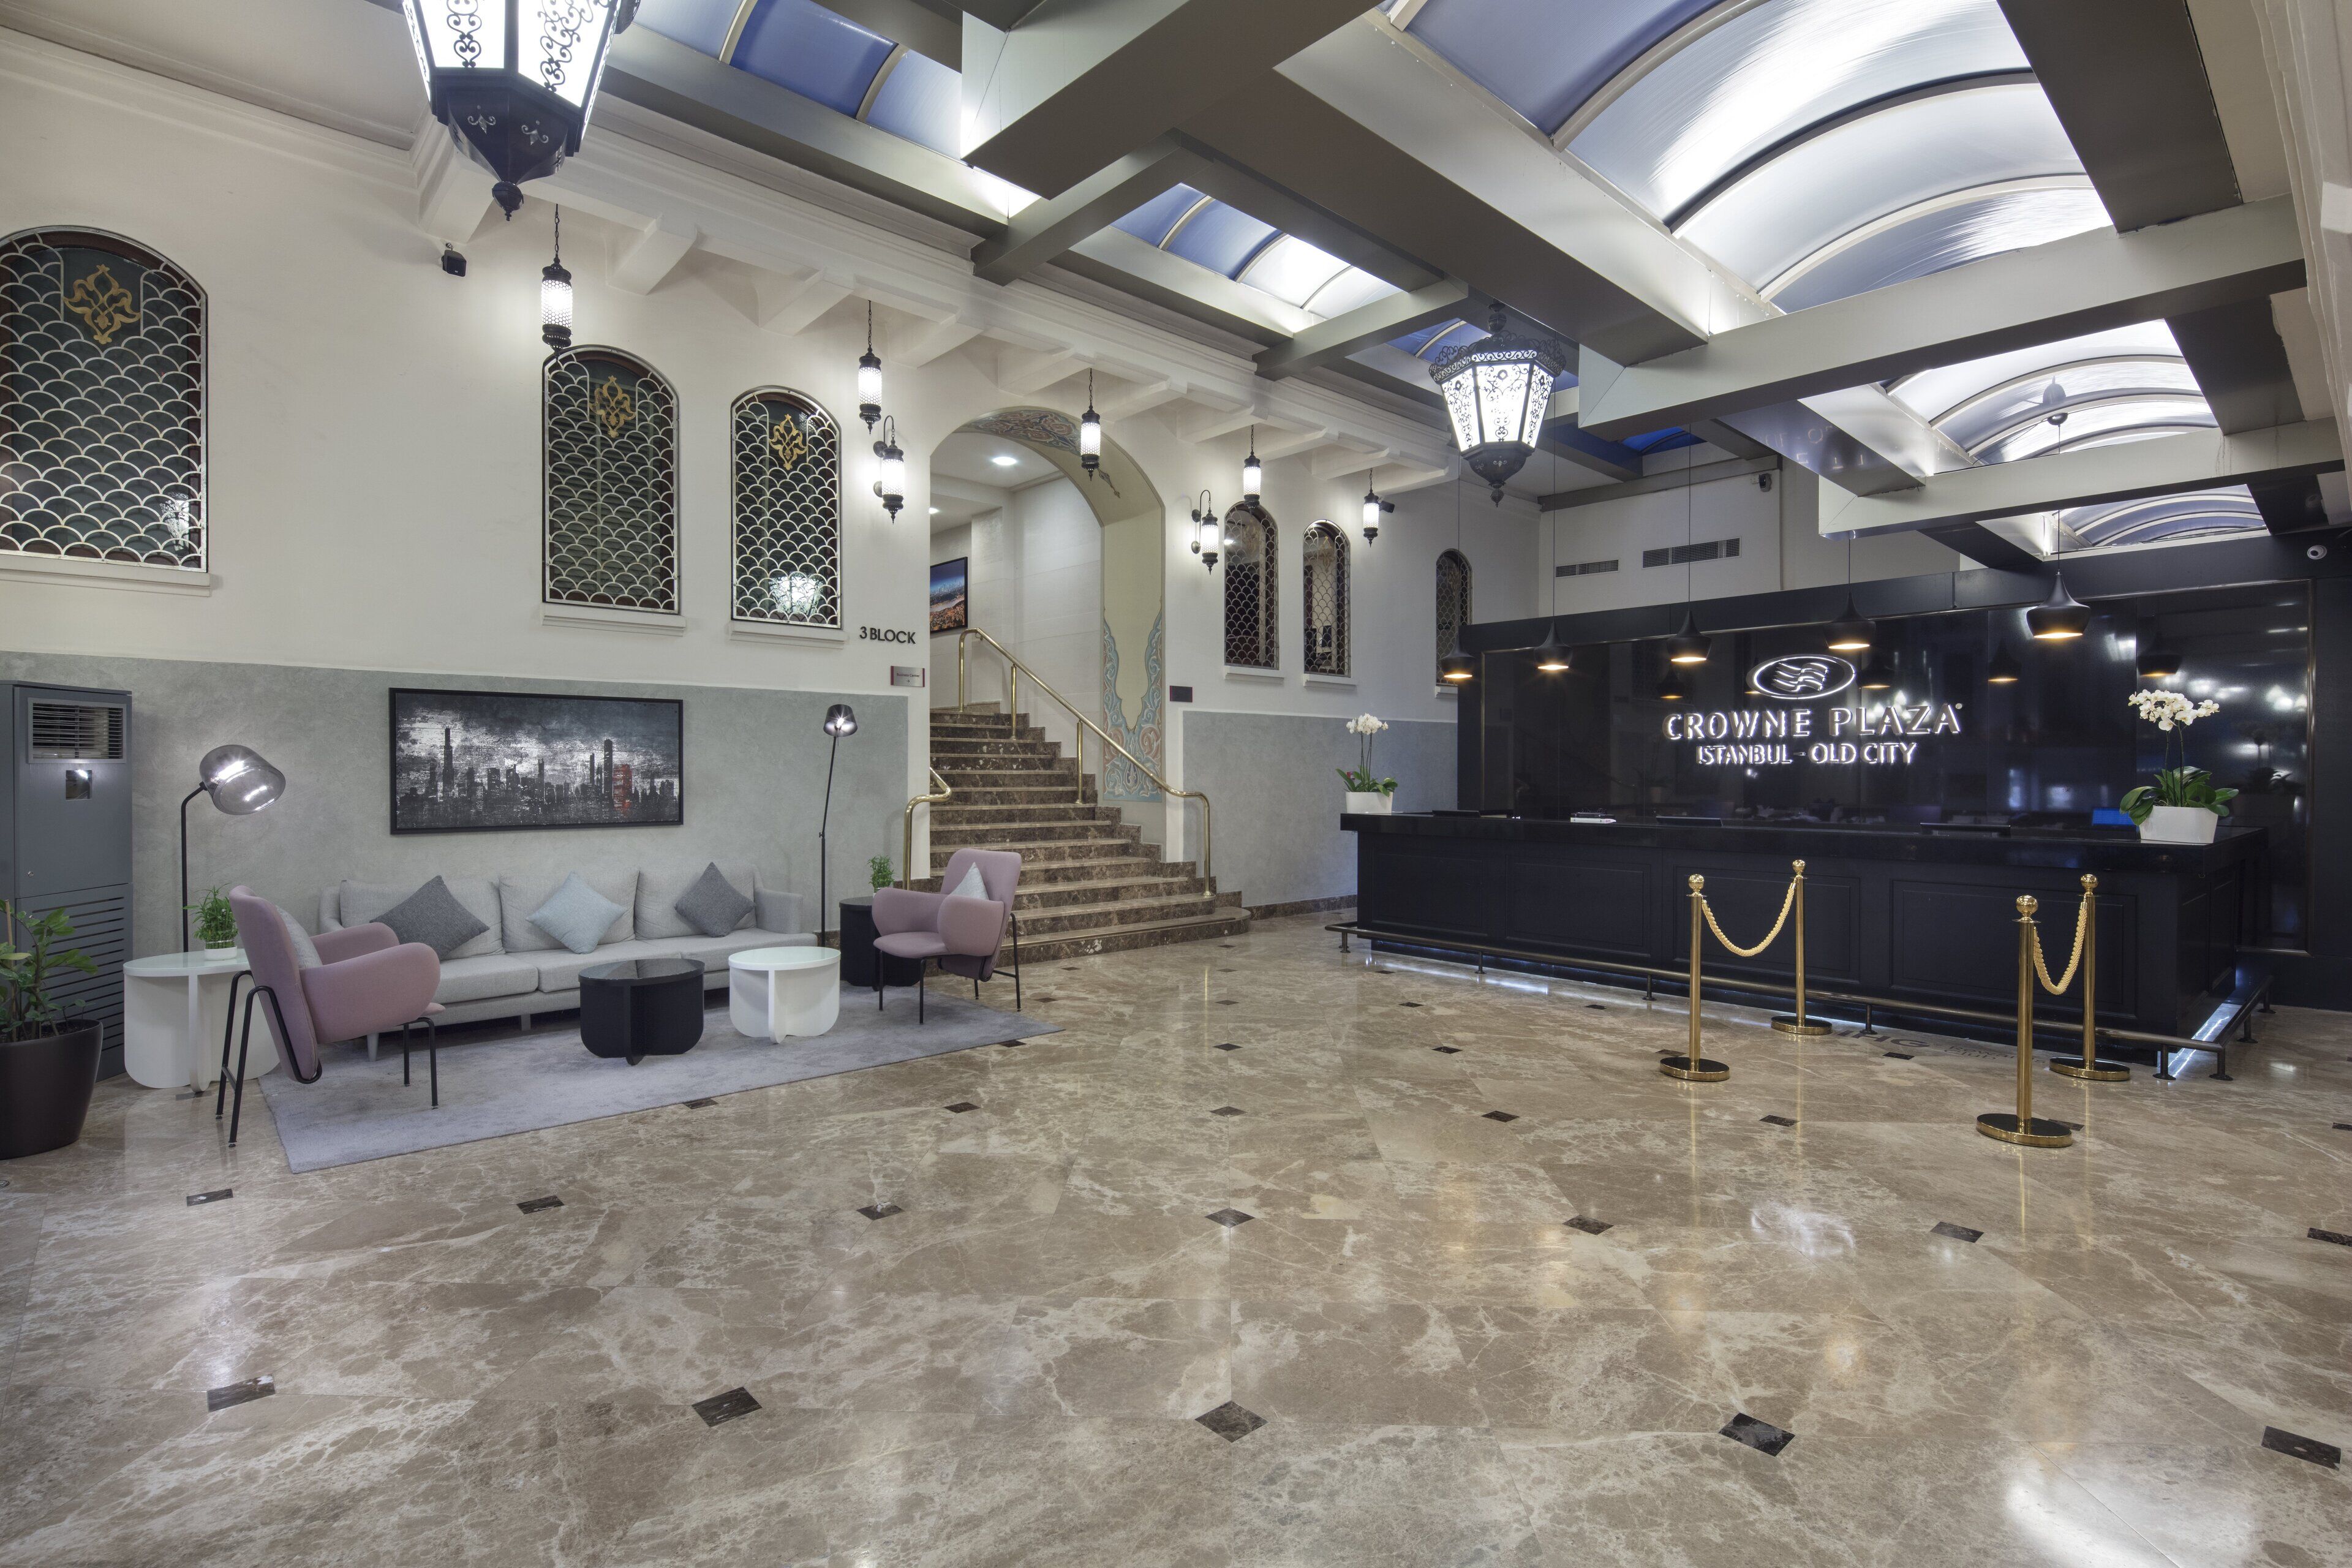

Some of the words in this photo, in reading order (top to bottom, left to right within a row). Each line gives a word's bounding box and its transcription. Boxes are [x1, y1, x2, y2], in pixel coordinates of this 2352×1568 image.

[859, 626, 867, 639] 3
[870, 628, 916, 644] BLOCK
[1662, 709, 1811, 740] CROWNE
[1696, 744, 1793, 765] ISTANBUL
[1808, 743, 1856, 764] OLD
[1860, 742, 1918, 764] CITY
[1838, 1030, 1931, 1047] IHG
